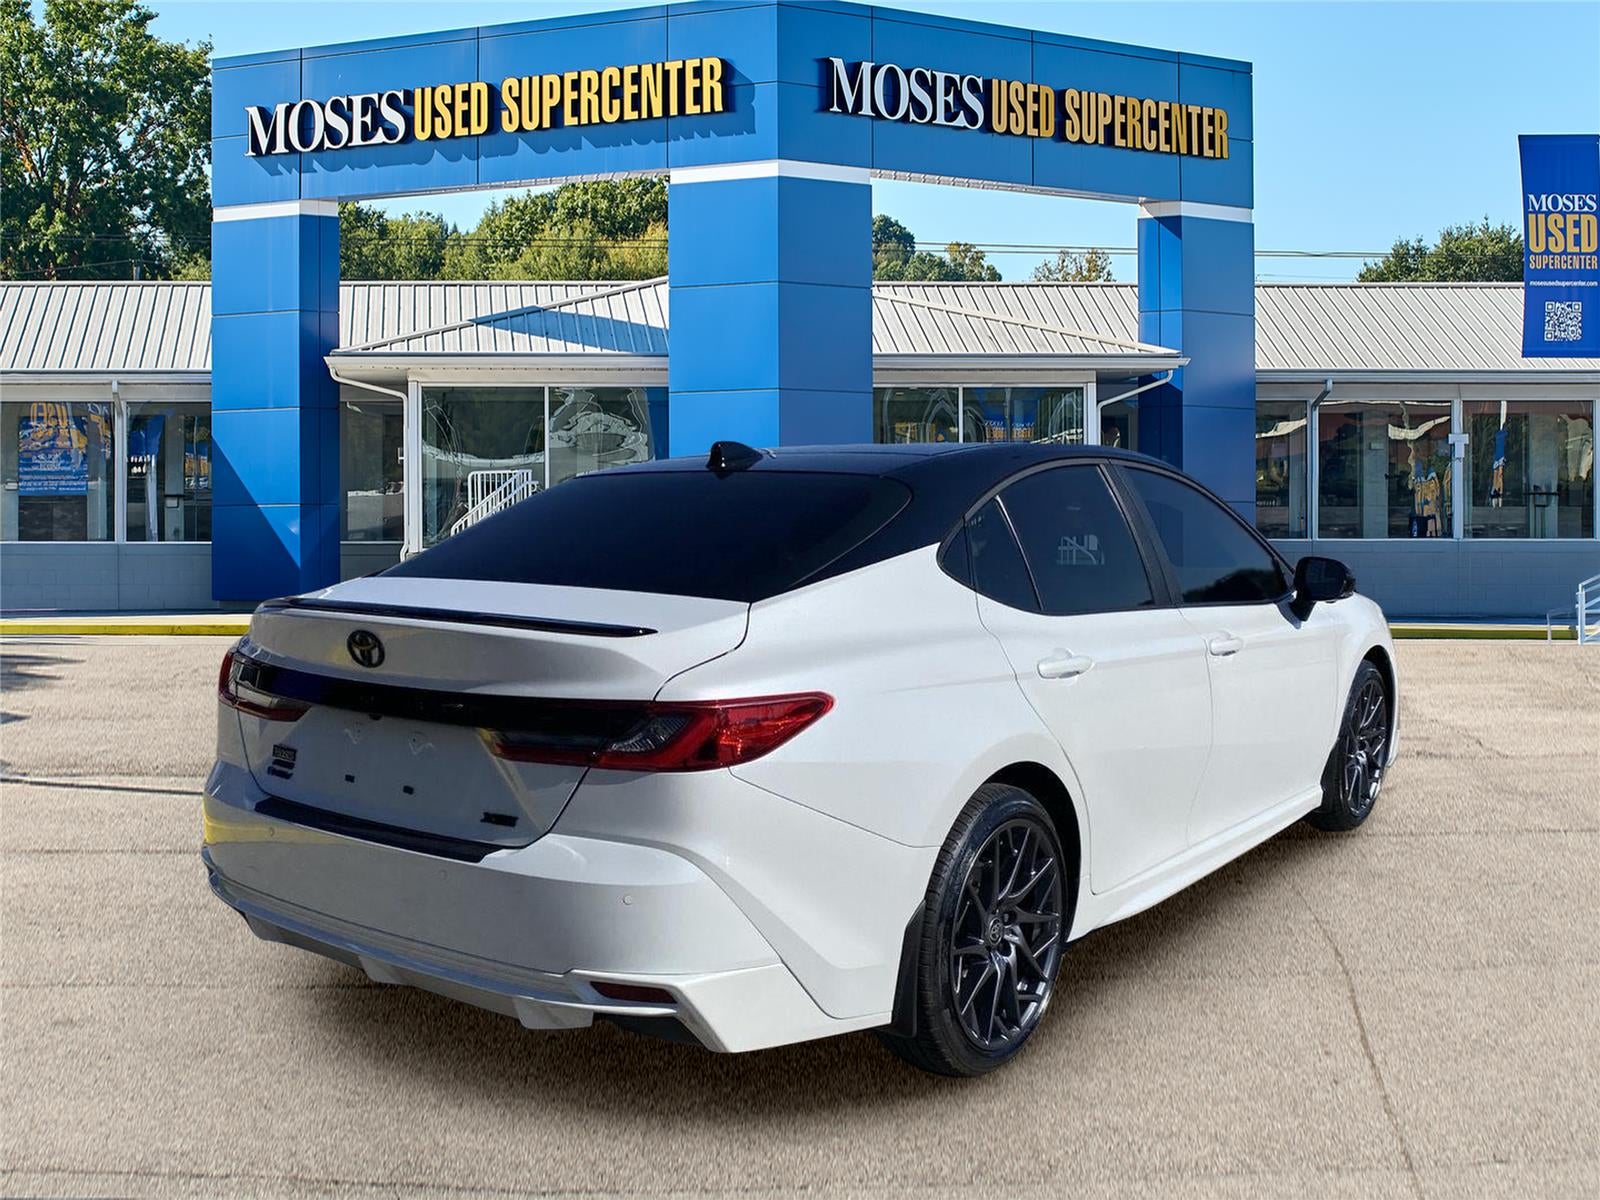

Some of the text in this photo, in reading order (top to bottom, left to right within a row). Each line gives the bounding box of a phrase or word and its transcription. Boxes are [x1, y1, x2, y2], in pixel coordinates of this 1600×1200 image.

[244, 56, 724, 158] MOSES USED SUPERCENTER
[828, 56, 1229, 159] MOSES USED SUPERCENTER
[1528, 194, 1597, 212] MOSES
[1528, 214, 1598, 253] USED
[1529, 255, 1598, 270] SUPERCENTER
